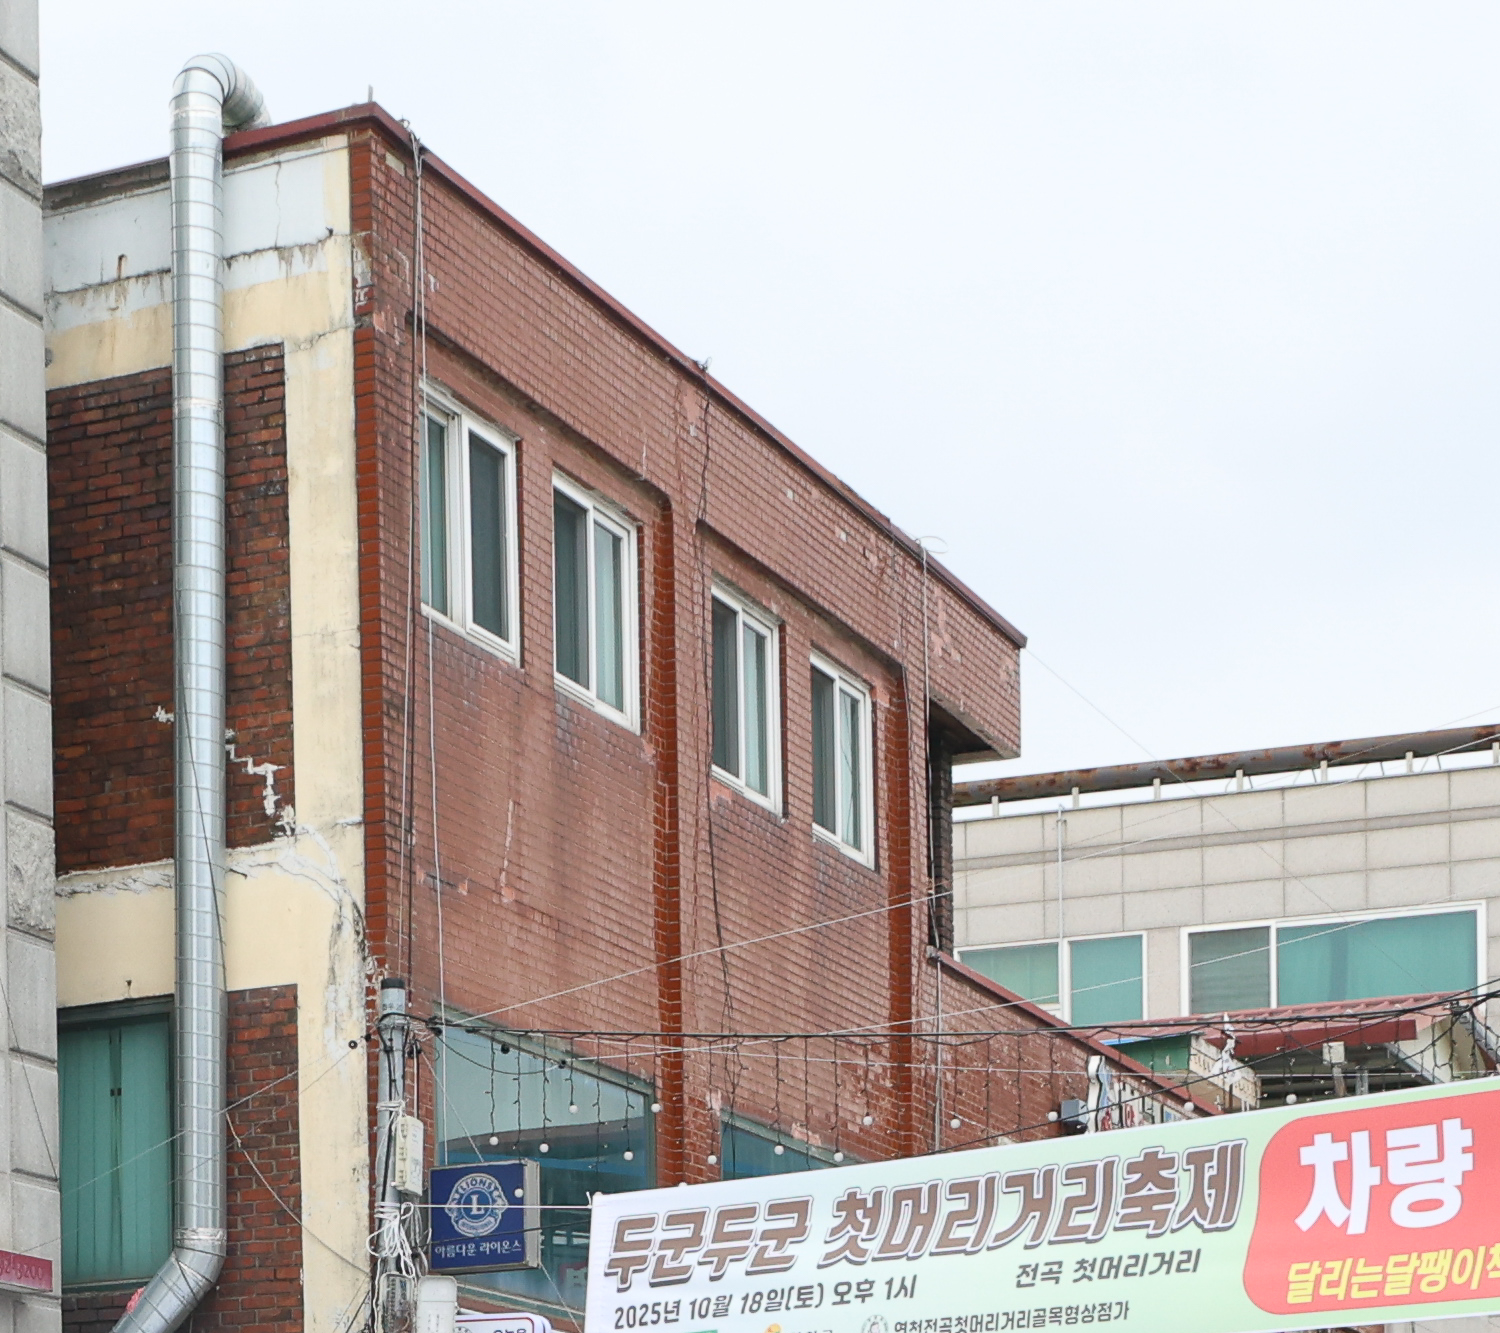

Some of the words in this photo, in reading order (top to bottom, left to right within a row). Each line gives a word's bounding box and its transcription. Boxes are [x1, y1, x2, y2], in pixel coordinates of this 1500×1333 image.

[457, 1176, 494, 1196] LIONS
[1295, 1115, 1477, 1239] 차량
[470, 1197, 485, 1215] L
[604, 1196, 812, 1291] 두군두군
[825, 1137, 1248, 1269] 첫머리거리축제
[434, 1244, 477, 1259] 아름다운
[479, 1240, 522, 1256] 라이온스
[1014, 1256, 1065, 1291] 전곡
[1072, 1247, 1202, 1284] 첫머리거리
[613, 1297, 683, 1332] 2025년
[688, 1291, 735, 1326] 10월
[738, 1281, 826, 1319] 18일(토)
[831, 1275, 879, 1310] 오후
[884, 1272, 918, 1303] 1시
